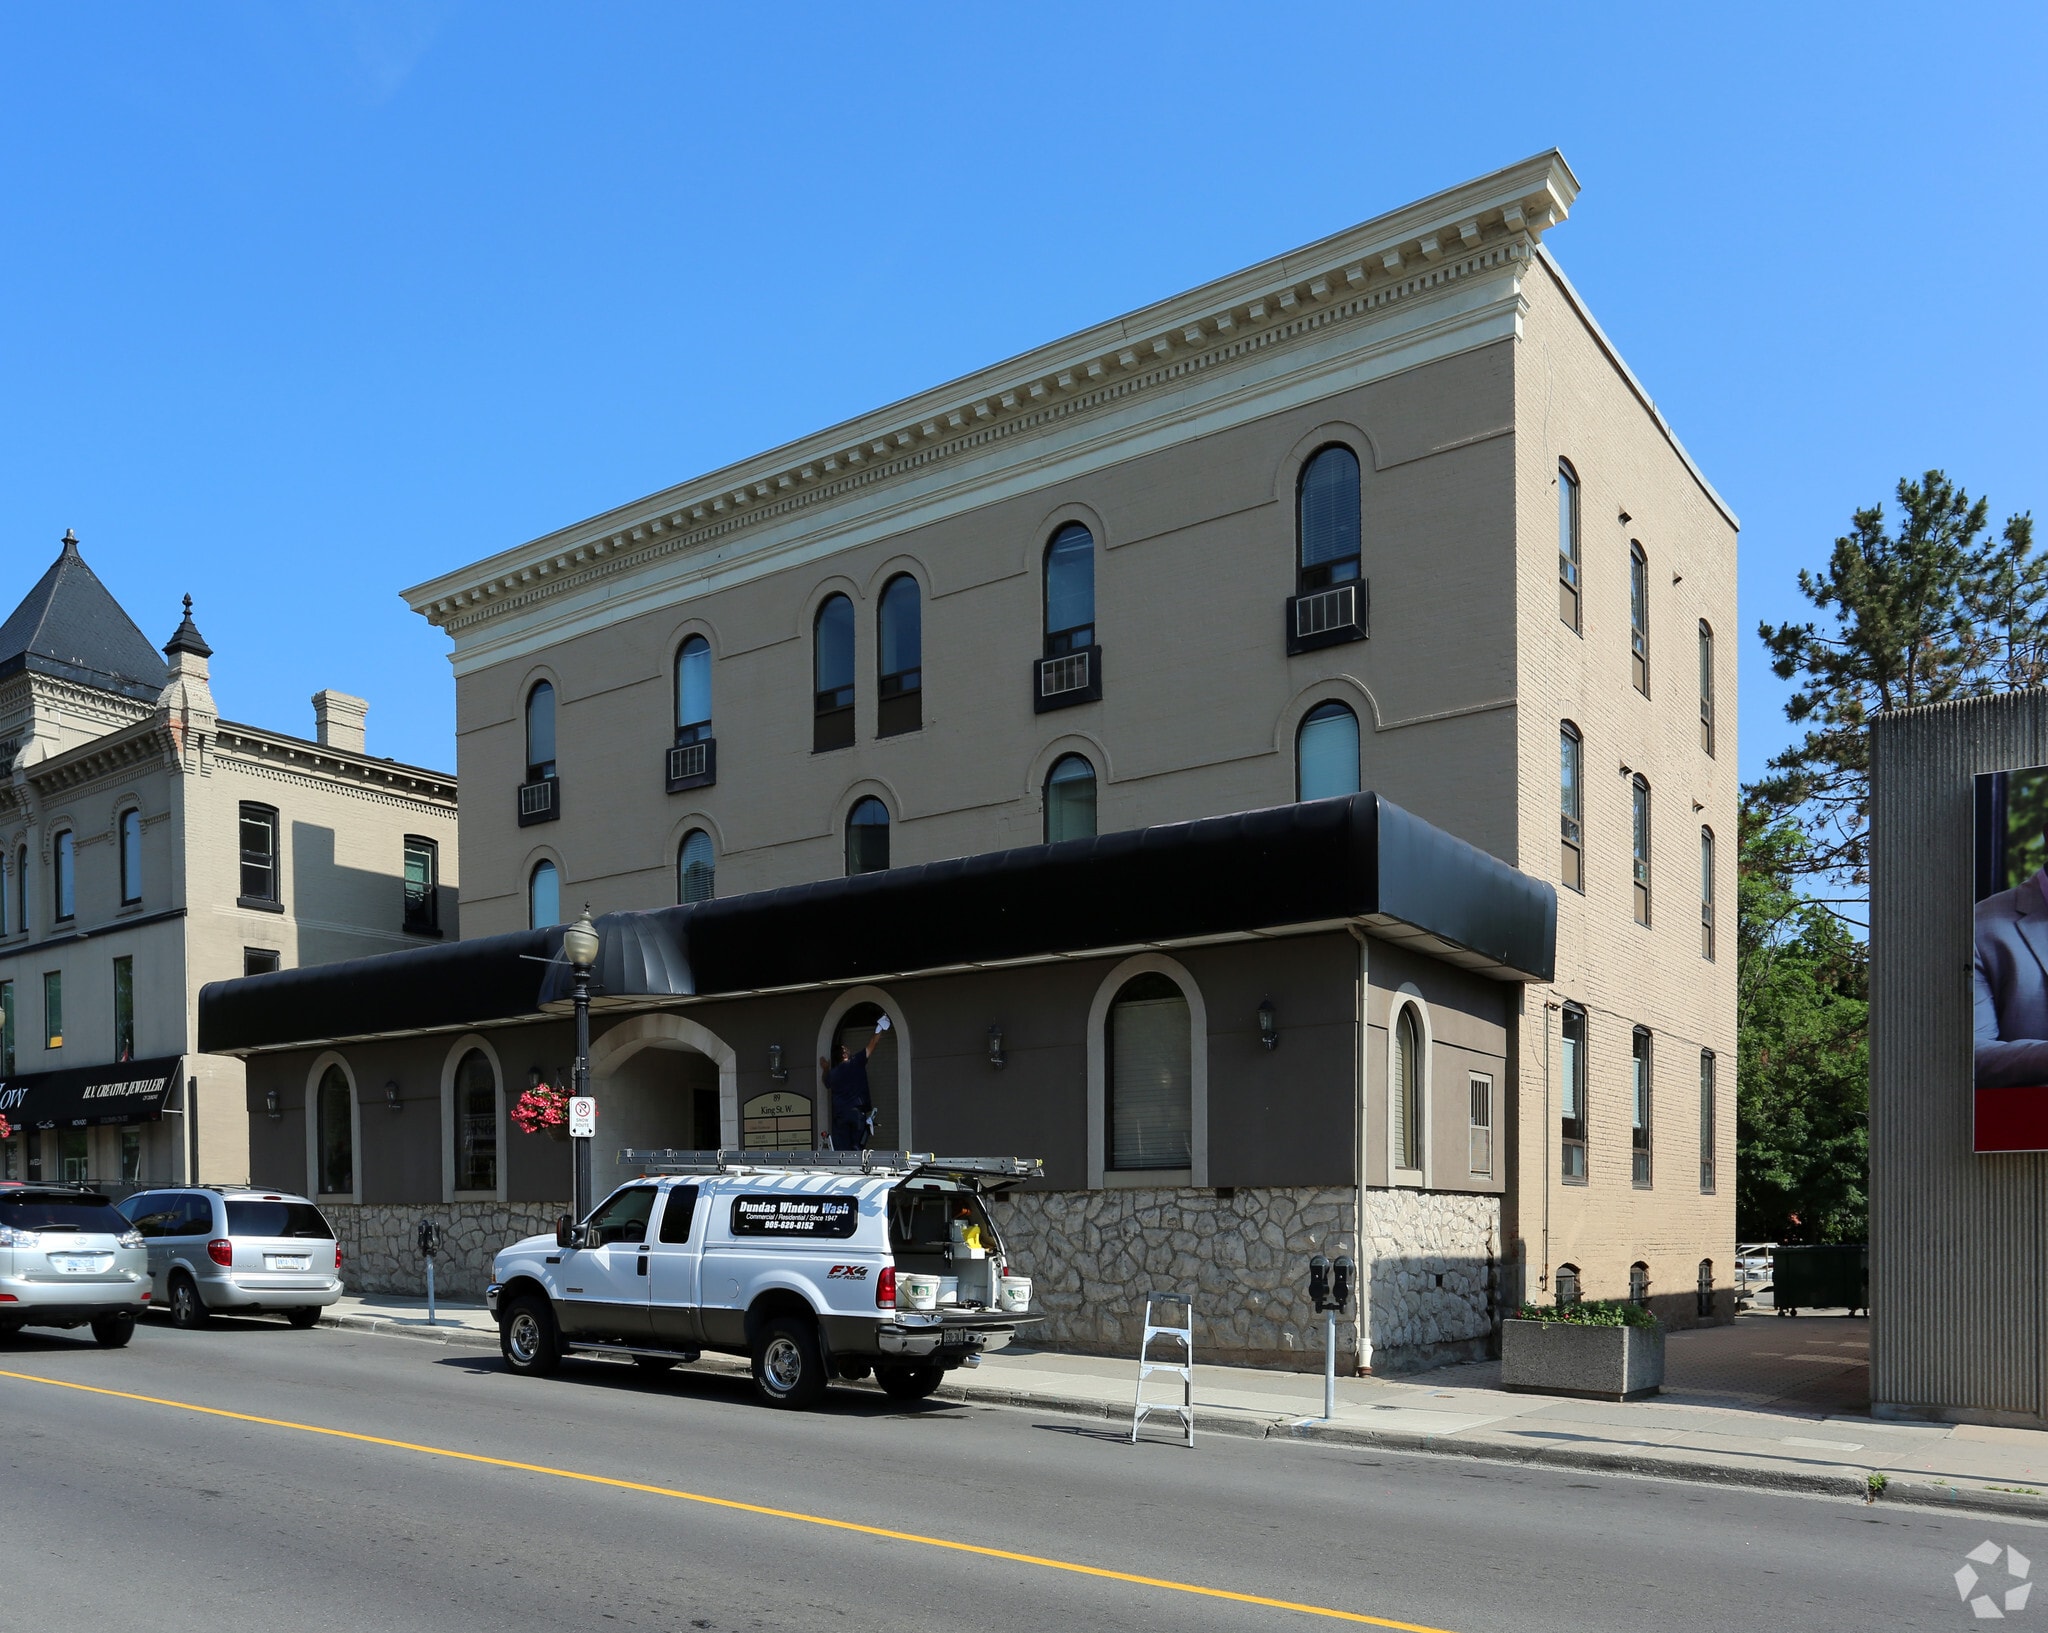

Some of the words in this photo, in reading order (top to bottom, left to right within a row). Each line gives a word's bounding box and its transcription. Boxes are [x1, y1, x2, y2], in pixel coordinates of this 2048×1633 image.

[96, 1082, 129, 1098] CREATIVE
[126, 1077, 168, 1096] JEWELLERY
[0, 1082, 29, 1110] OW
[773, 1094, 781, 1102] 89
[761, 1106, 776, 1115] King
[784, 1105, 794, 1113] W.
[739, 1201, 777, 1213] Dundas
[780, 1202, 819, 1214] Window
[822, 1203, 849, 1215] Wash
[828, 1265, 869, 1276] FX4
